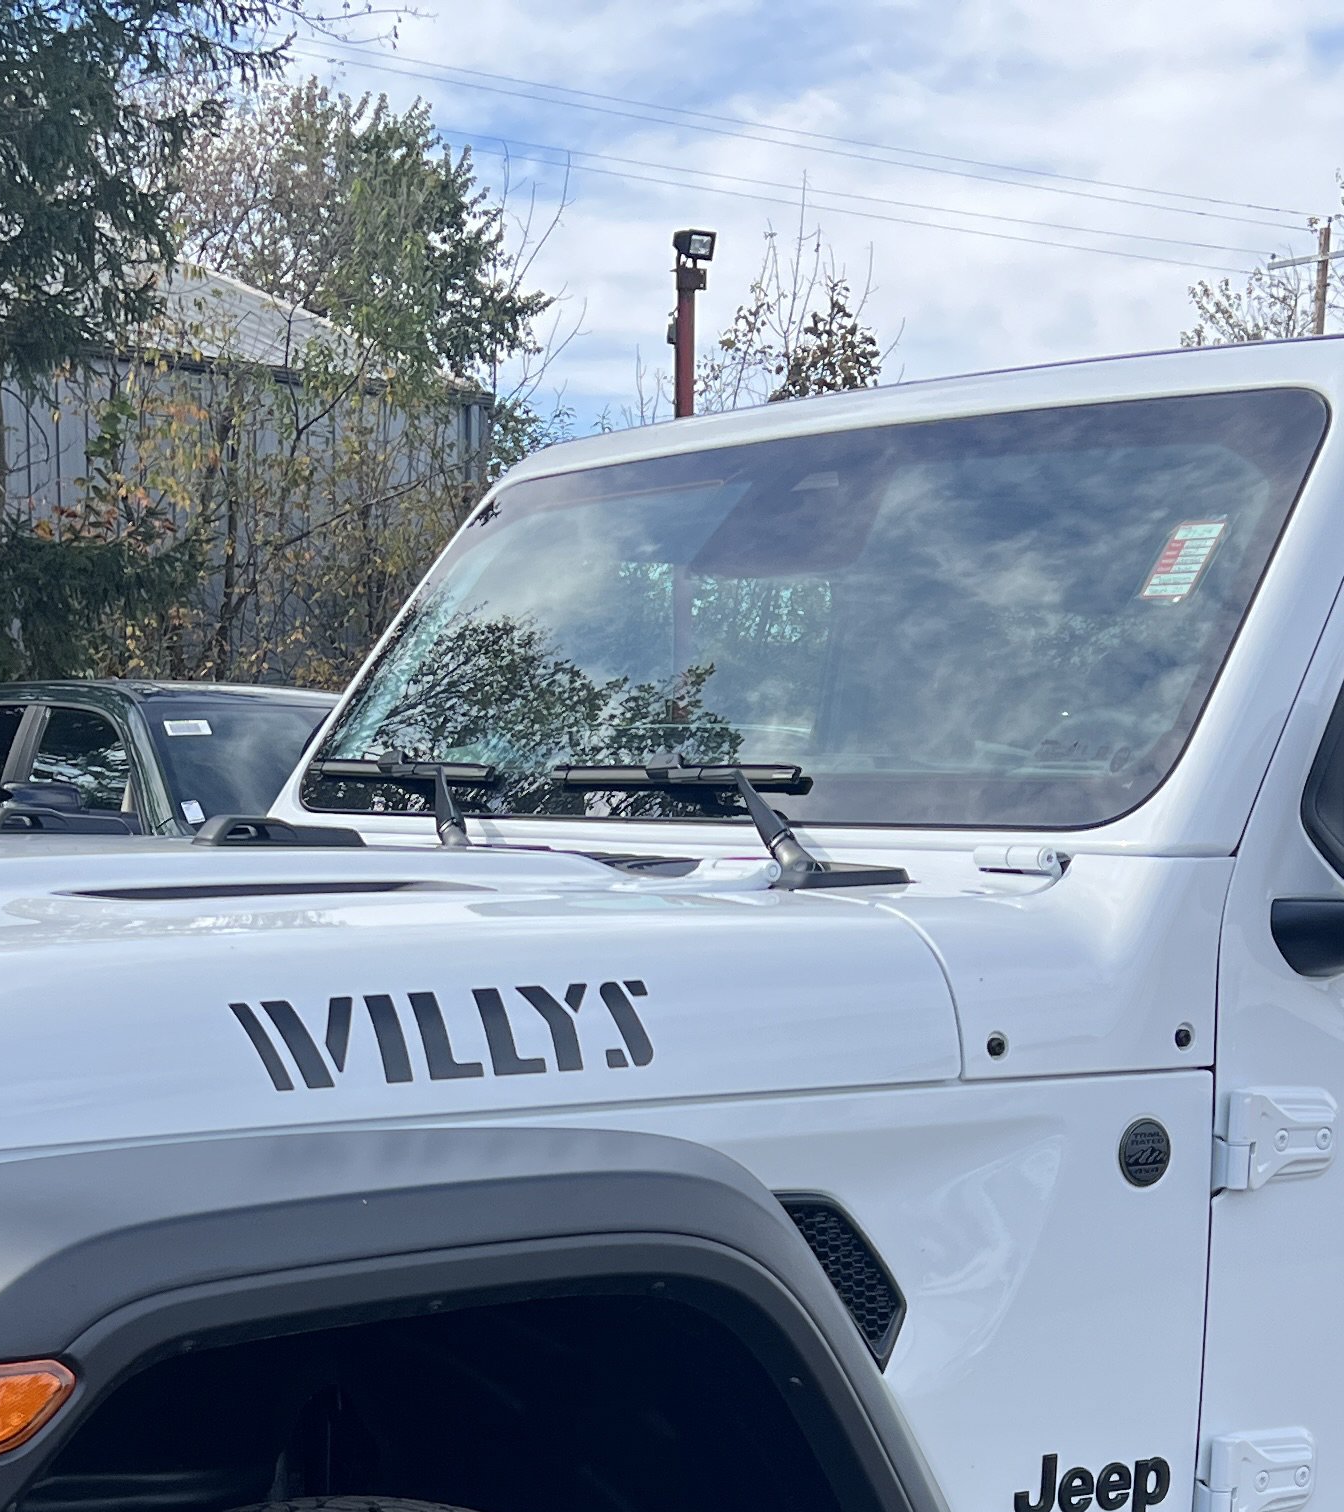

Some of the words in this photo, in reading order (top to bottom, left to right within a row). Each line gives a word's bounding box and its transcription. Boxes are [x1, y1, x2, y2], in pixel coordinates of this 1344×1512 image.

[229, 980, 654, 1091] WILLYS
[1133, 1131, 1162, 1139] TRAIL
[1131, 1138, 1165, 1146] RATED
